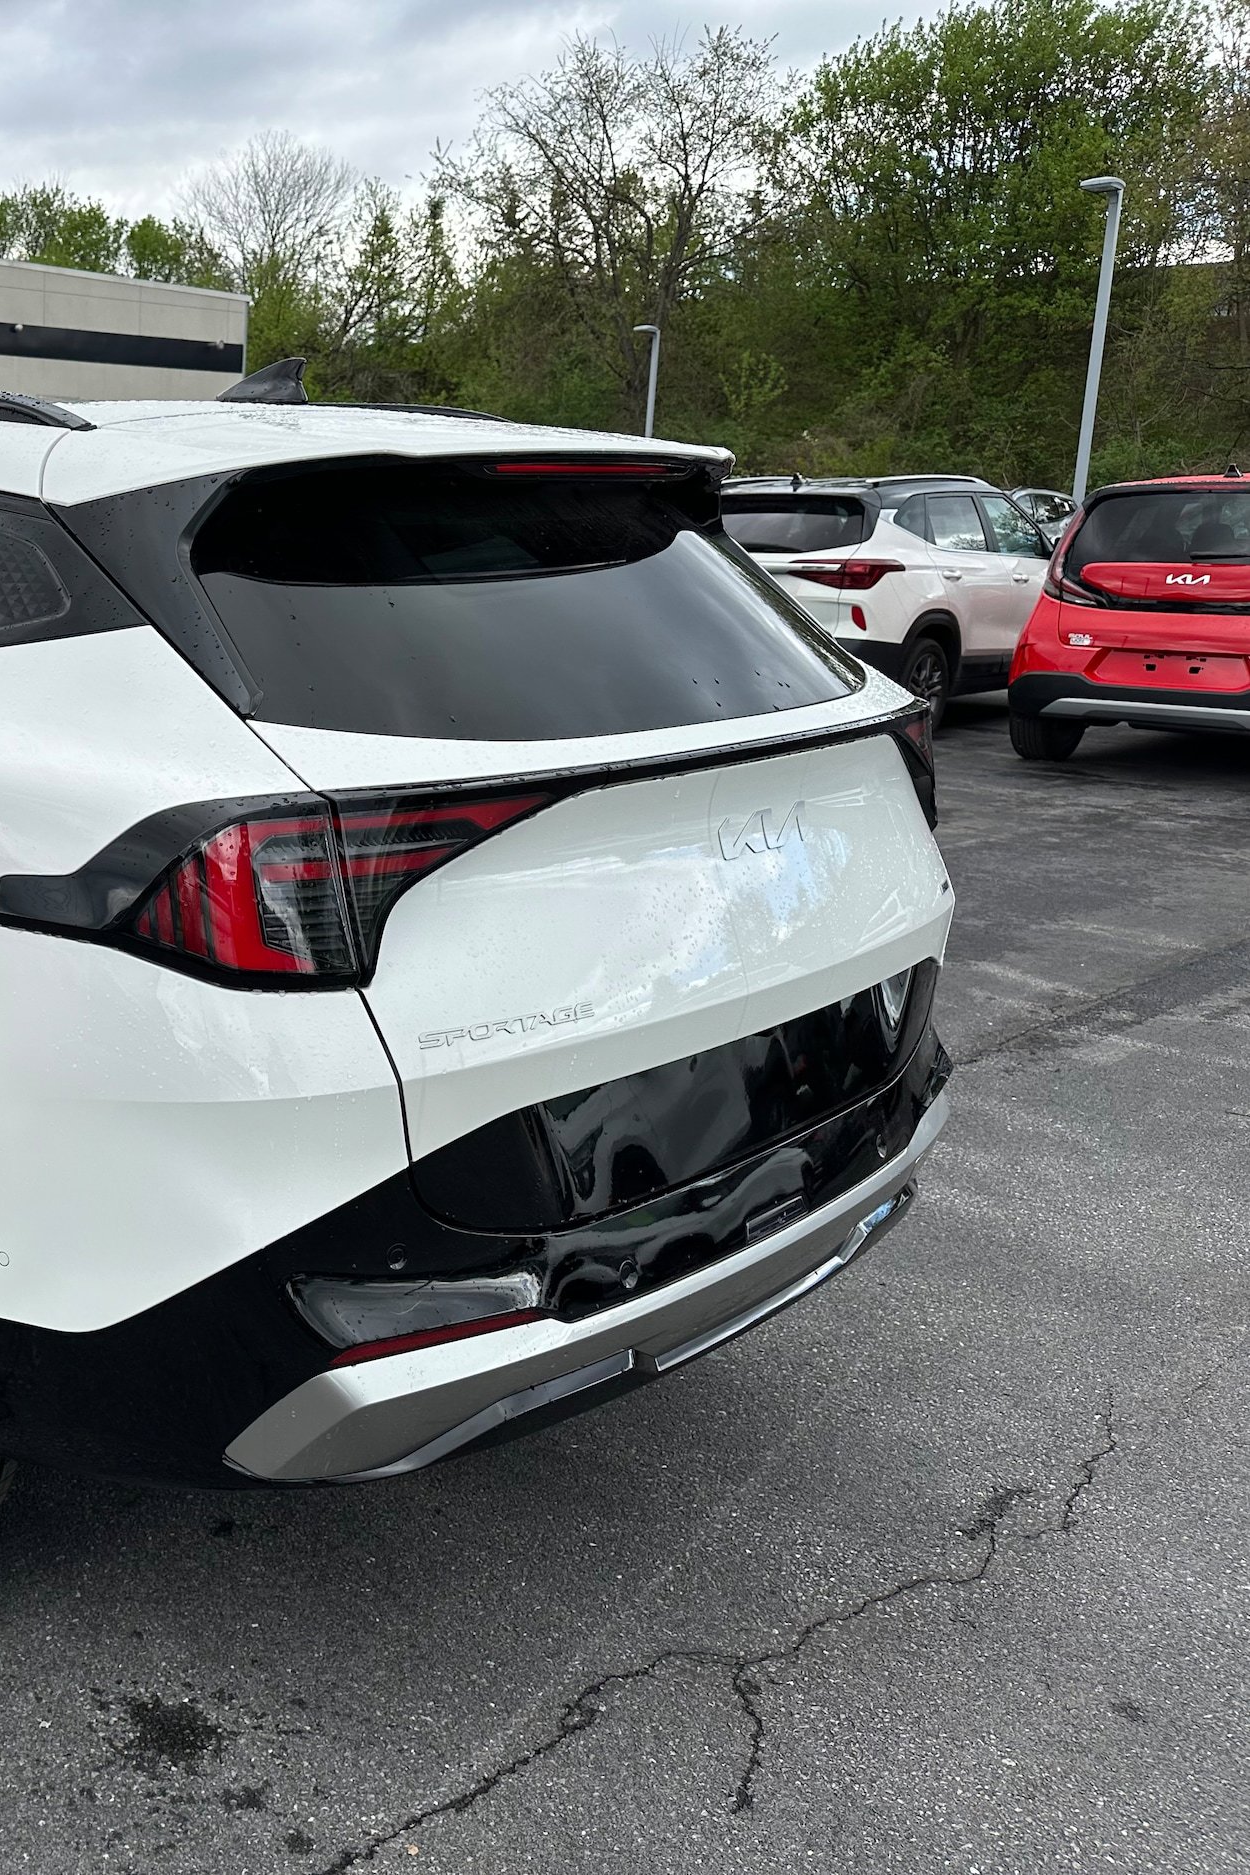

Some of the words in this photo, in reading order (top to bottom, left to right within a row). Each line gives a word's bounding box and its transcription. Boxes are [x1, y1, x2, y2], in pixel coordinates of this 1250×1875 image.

[1165, 573, 1211, 585] KIA
[717, 800, 805, 861] KIA
[418, 1000, 595, 1050] SPORTAGE
